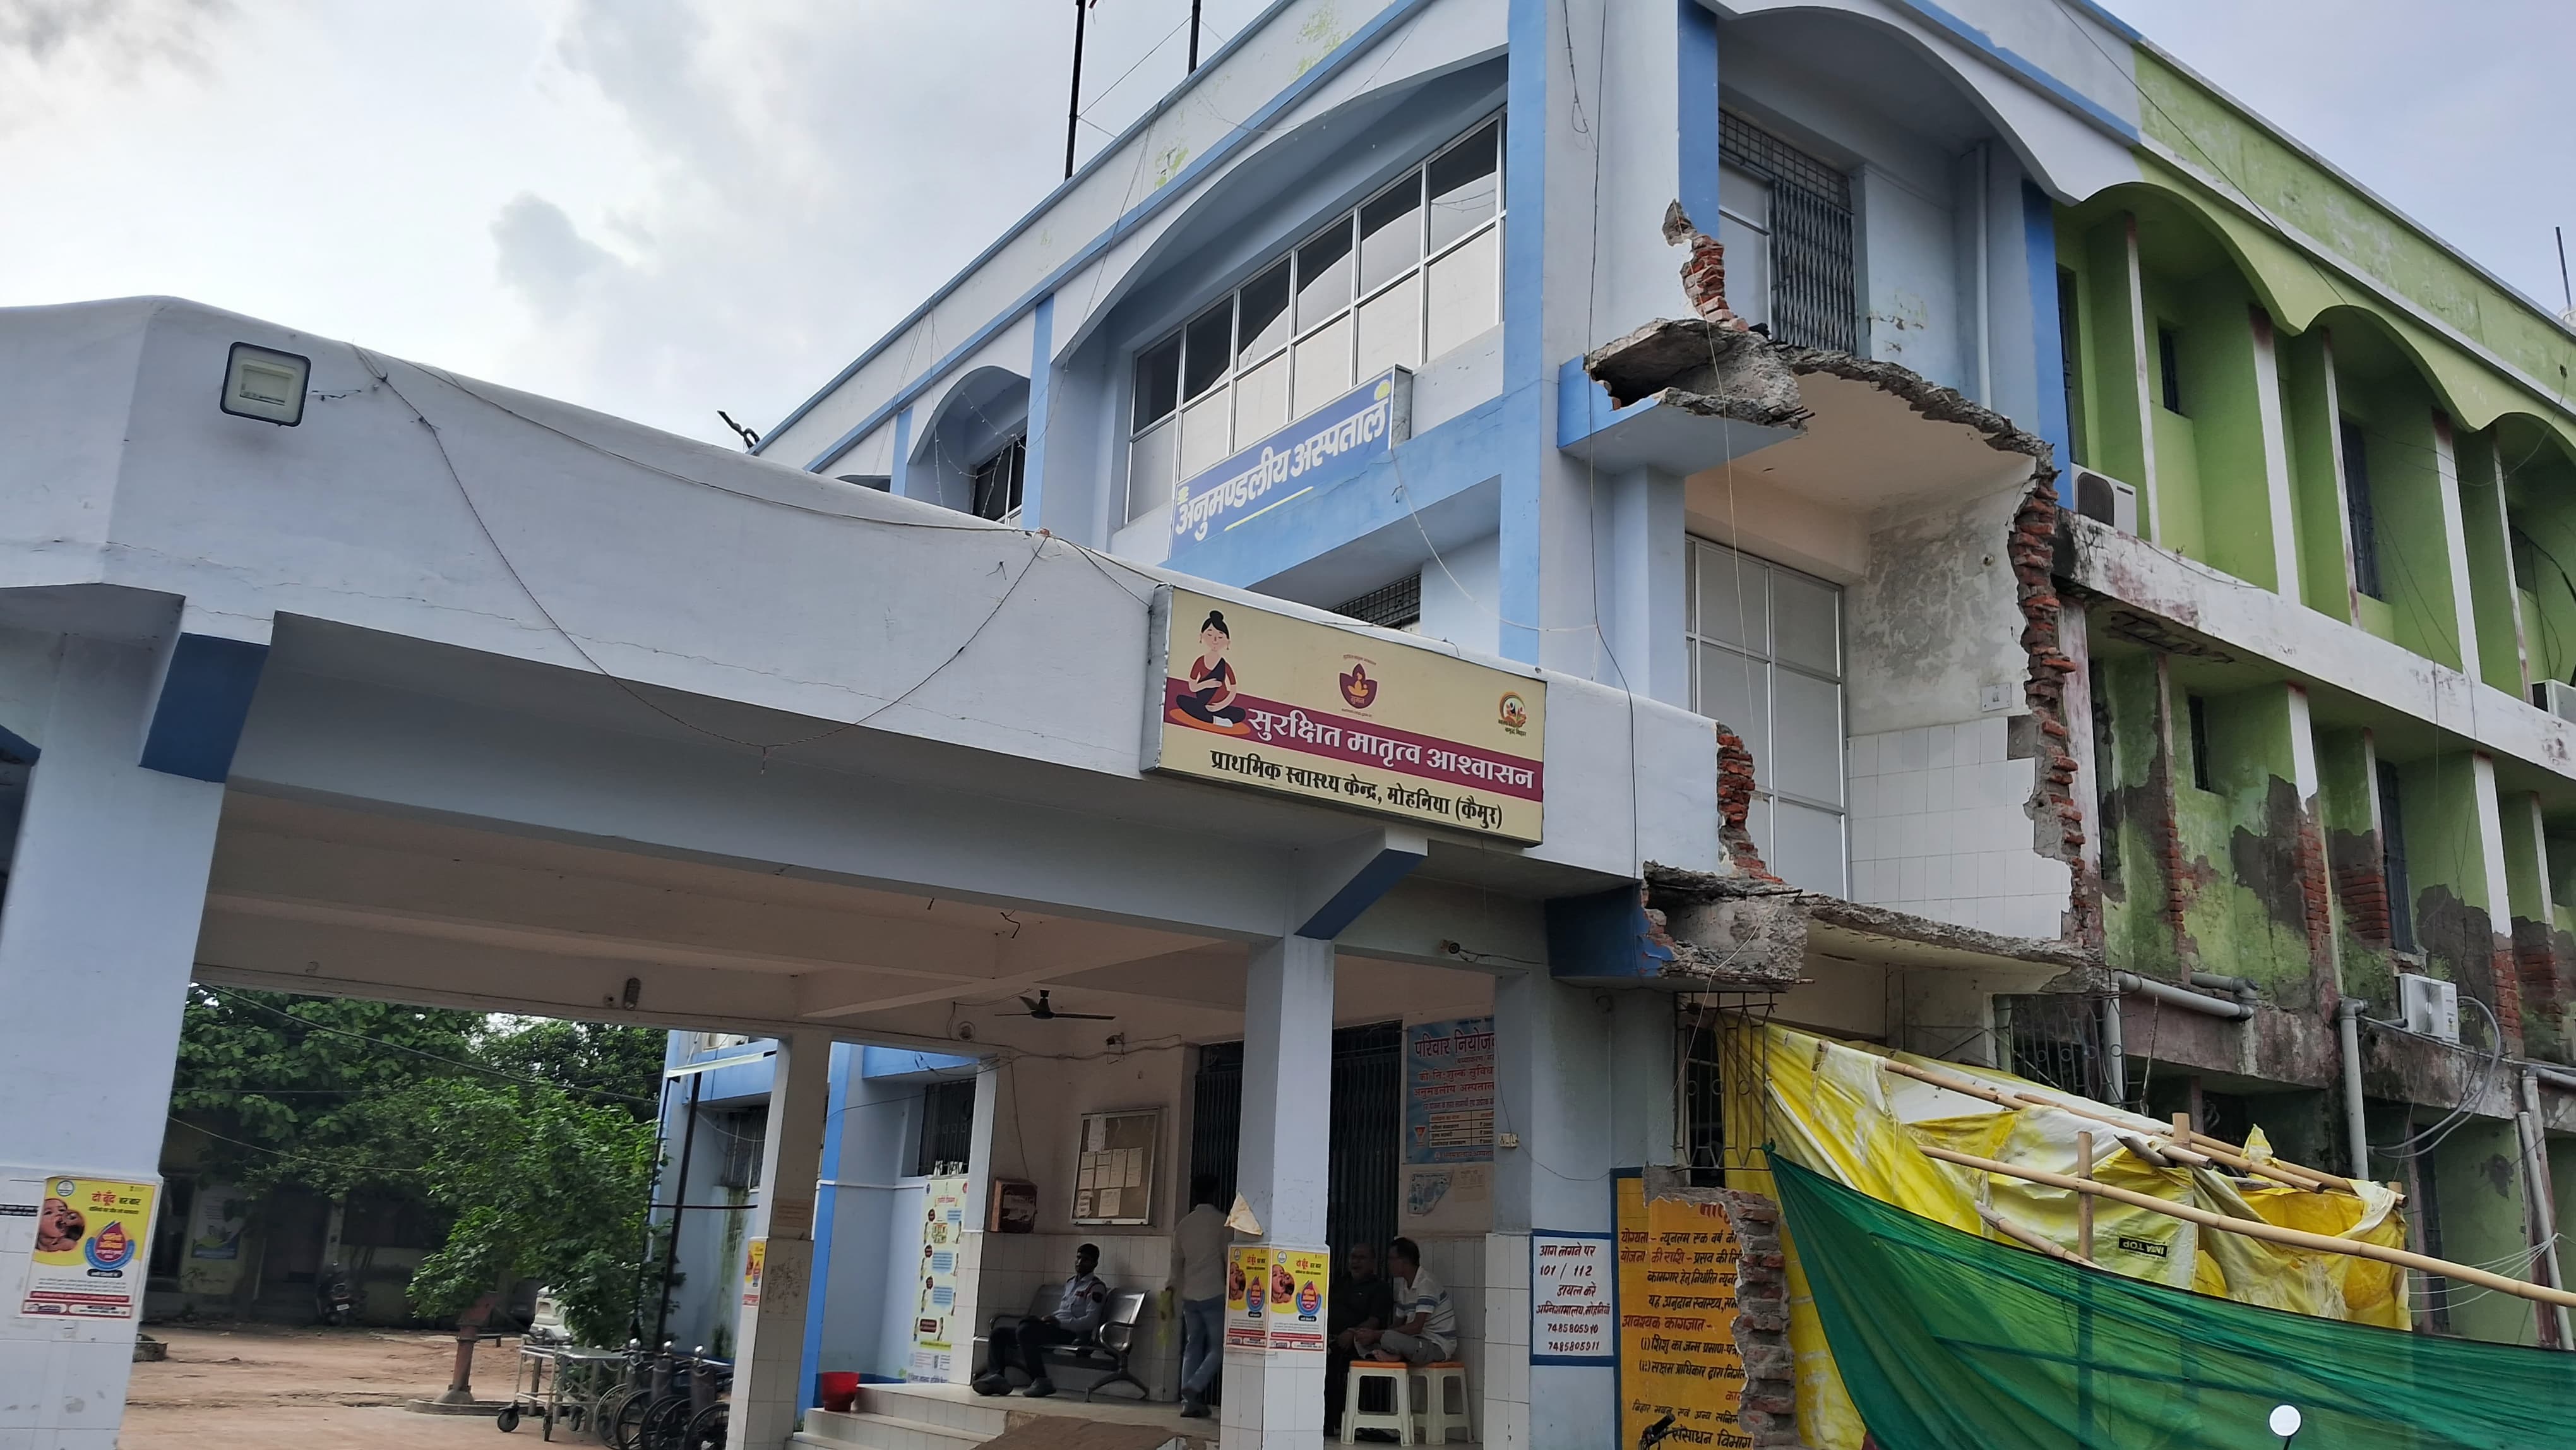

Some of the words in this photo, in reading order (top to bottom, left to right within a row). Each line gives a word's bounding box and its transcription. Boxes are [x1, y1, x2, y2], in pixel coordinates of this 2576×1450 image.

[1176, 446, 1291, 541] अनुमण्डलीय
[1290, 398, 1390, 477] अस्पताल
[1248, 708, 1343, 748] सुरक्षित
[1347, 731, 1421, 767] मातृत्व
[1427, 748, 1534, 789] आश्वासन
[1210, 750, 1282, 780] प्राथमिक
[1285, 766, 1342, 792] स्वास्थ्य
[1344, 774, 1382, 805] केन्द्र,
[1387, 782, 1451, 815] मोहनिया
[1455, 795, 1503, 829] (कैमुर)
[1414, 1033, 1450, 1057] परिवार
[1711, 1229, 1722, 1243] वर्ष
[1539, 1245, 1558, 1257] आग
[1558, 1242, 1582, 1257] लगने
[1584, 1245, 1596, 1257] पर
[2123, 1240, 2145, 1250] TOP
[1620, 1247, 1647, 1262] योजना
[1652, 1247, 1663, 1263] की
[1693, 1252, 1714, 1265] प्रसव
[1715, 1249, 1728, 1264] की
[1540, 1265, 1556, 1276] 101
[1574, 1265, 1593, 1276] 112
[1647, 1271, 1679, 1284] कामगार
[1680, 1269, 1691, 1286] हेतु
[1557, 1285, 1583, 1297] डायल
[1649, 1295, 1662, 1307] यह
[1662, 1295, 1693, 1310] अनुदान
[1547, 1322, 1599, 1334] 7485805910
[1622, 1315, 1661, 1328] आवश्यक
[1548, 1341, 1600, 1353] 7485805911
[1651, 1334, 1670, 1354] शिशु
[1671, 1340, 1683, 1350] का
[1683, 1341, 1702, 1353] जन्म
[1675, 1360, 1706, 1378] प्राधिकार
[1708, 1367, 1724, 1381] द्वारा
[1632, 1399, 1650, 1413] बिहार
[1677, 1406, 1691, 1418] एवं
[1694, 1410, 1712, 1420] अन्य
[1717, 1429, 1752, 1449] विभाग
